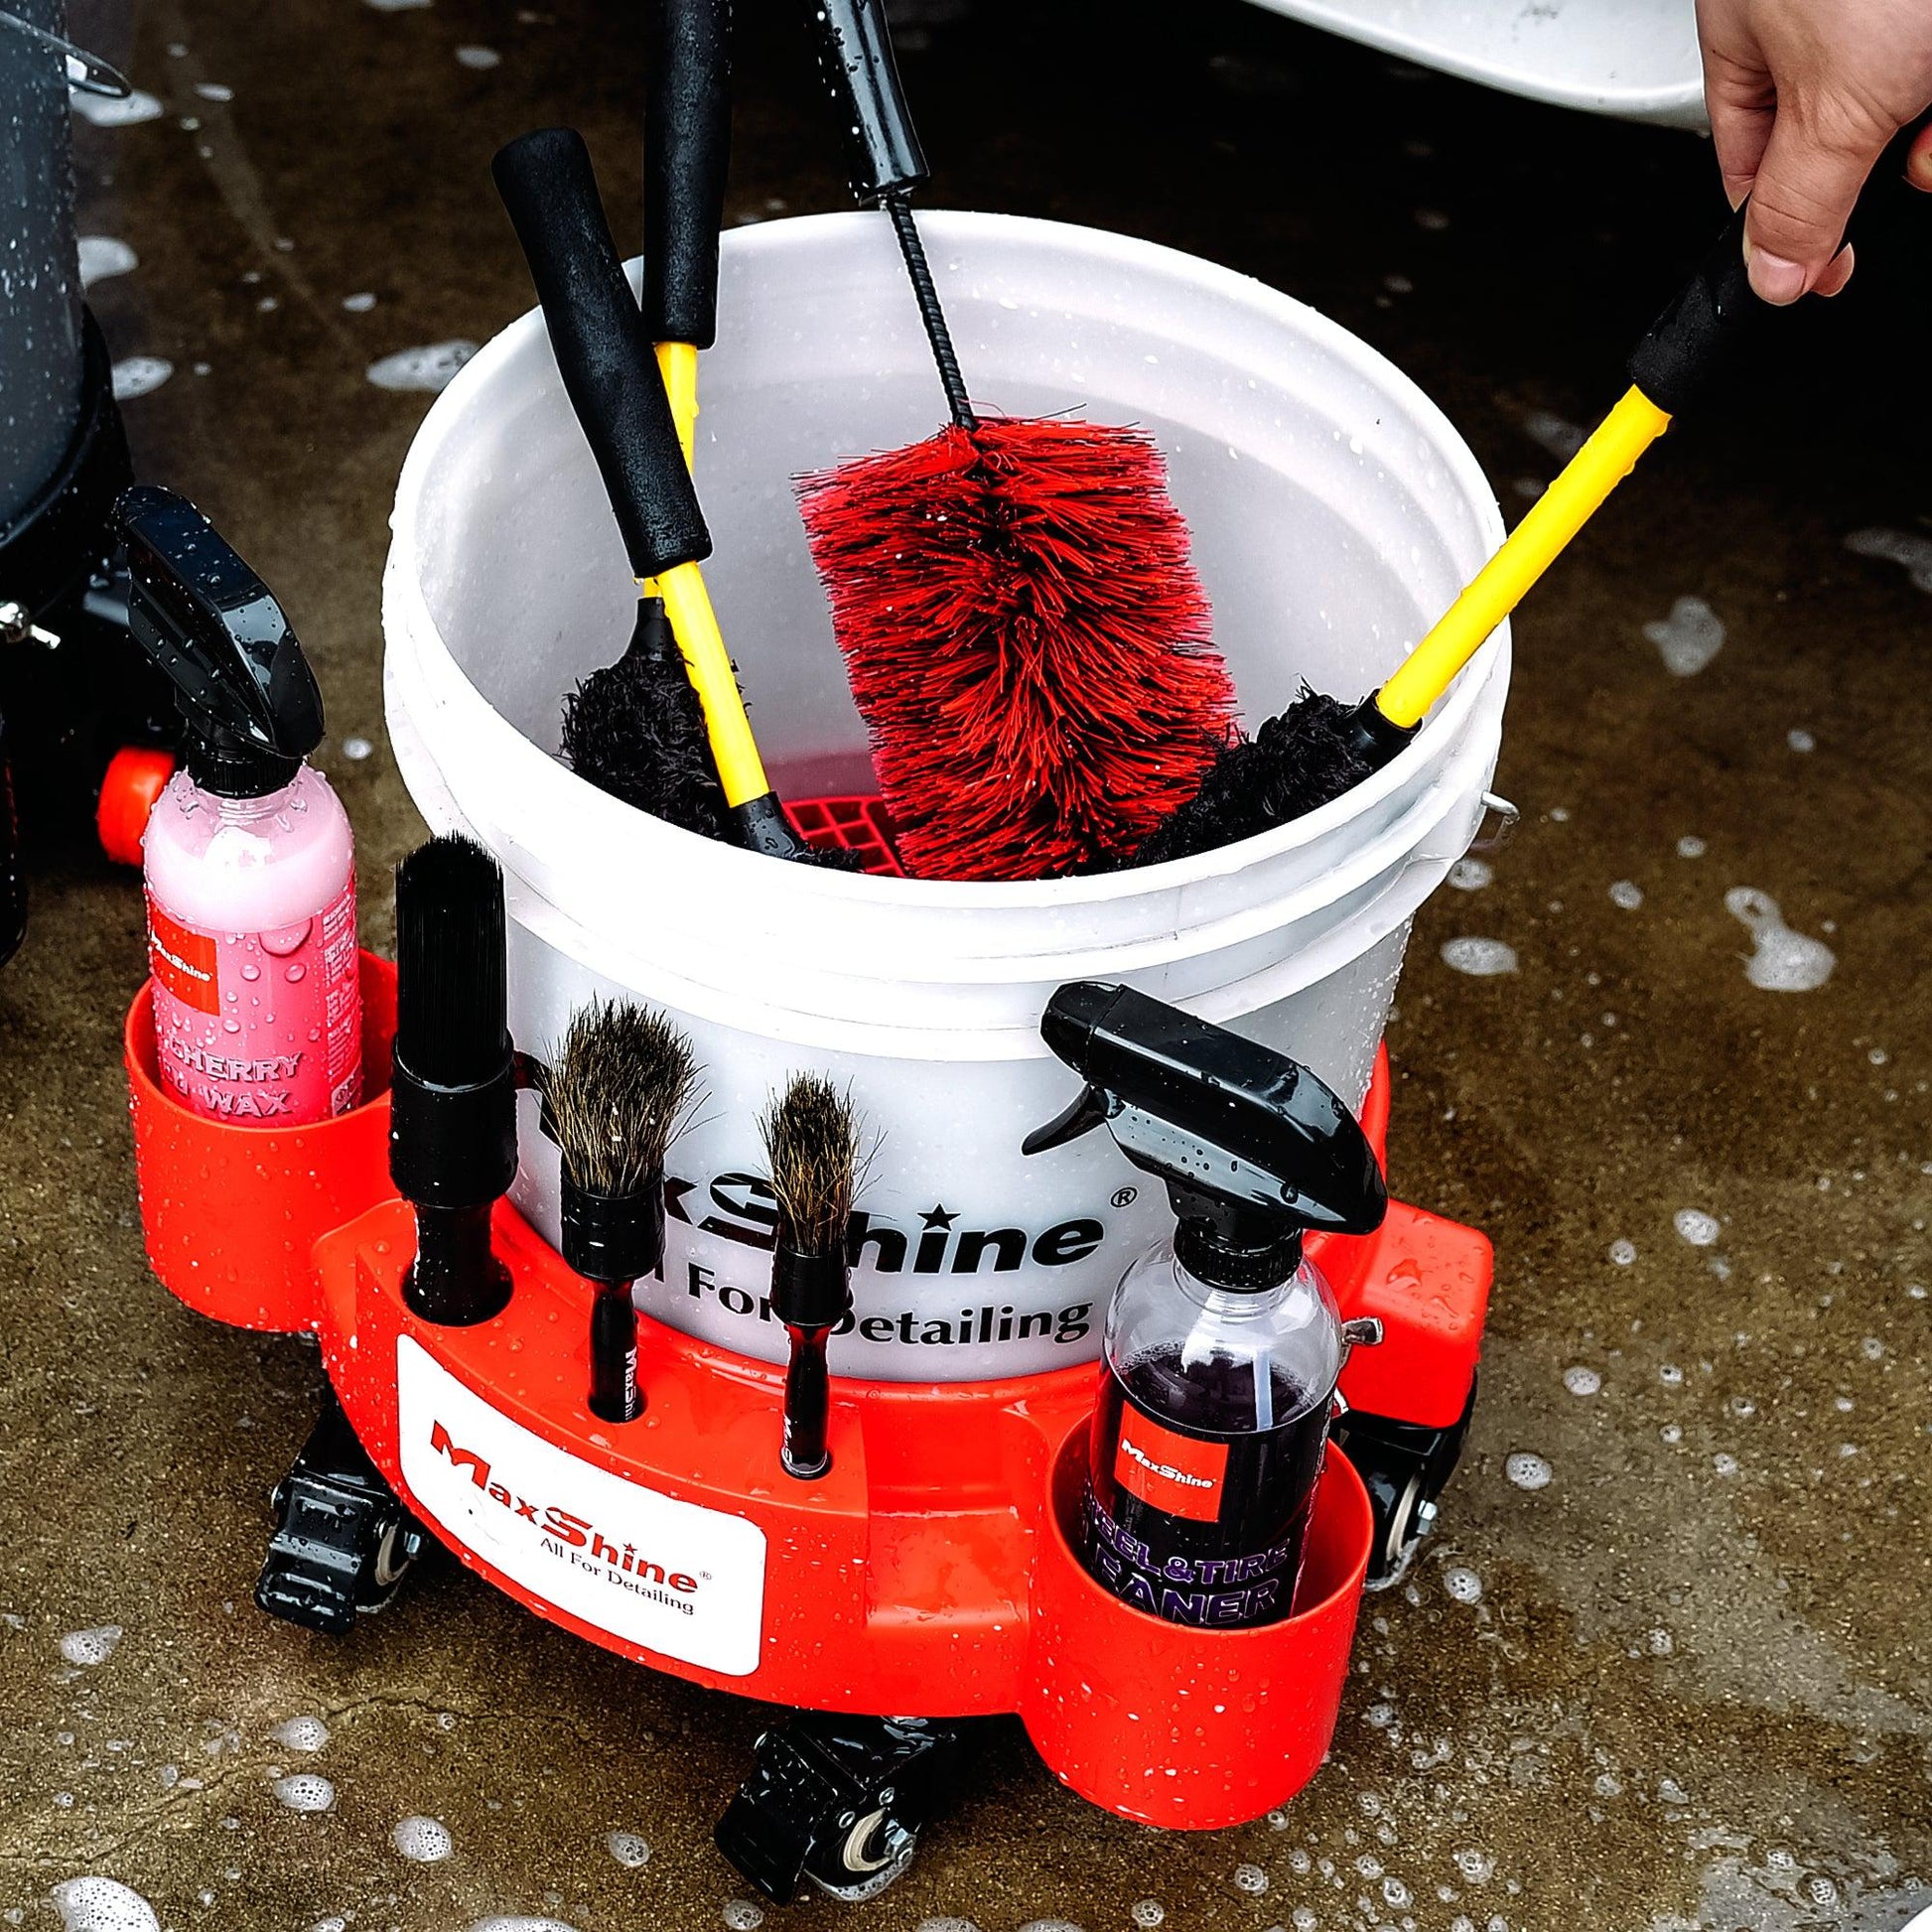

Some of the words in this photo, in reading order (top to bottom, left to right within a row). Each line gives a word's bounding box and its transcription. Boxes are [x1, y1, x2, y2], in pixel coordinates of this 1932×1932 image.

[170, 1033, 301, 1082] CHERRY
[200, 1085, 293, 1118] WAX
[830, 1302, 1093, 1344] etailing
[1121, 1439, 1213, 1489] MaxShine
[430, 1420, 698, 1593] MaxShine
[1092, 1496, 1290, 1585] EEL&TIRE
[540, 1537, 564, 1559] All
[571, 1552, 601, 1576] For
[608, 1570, 695, 1615] Detailing
